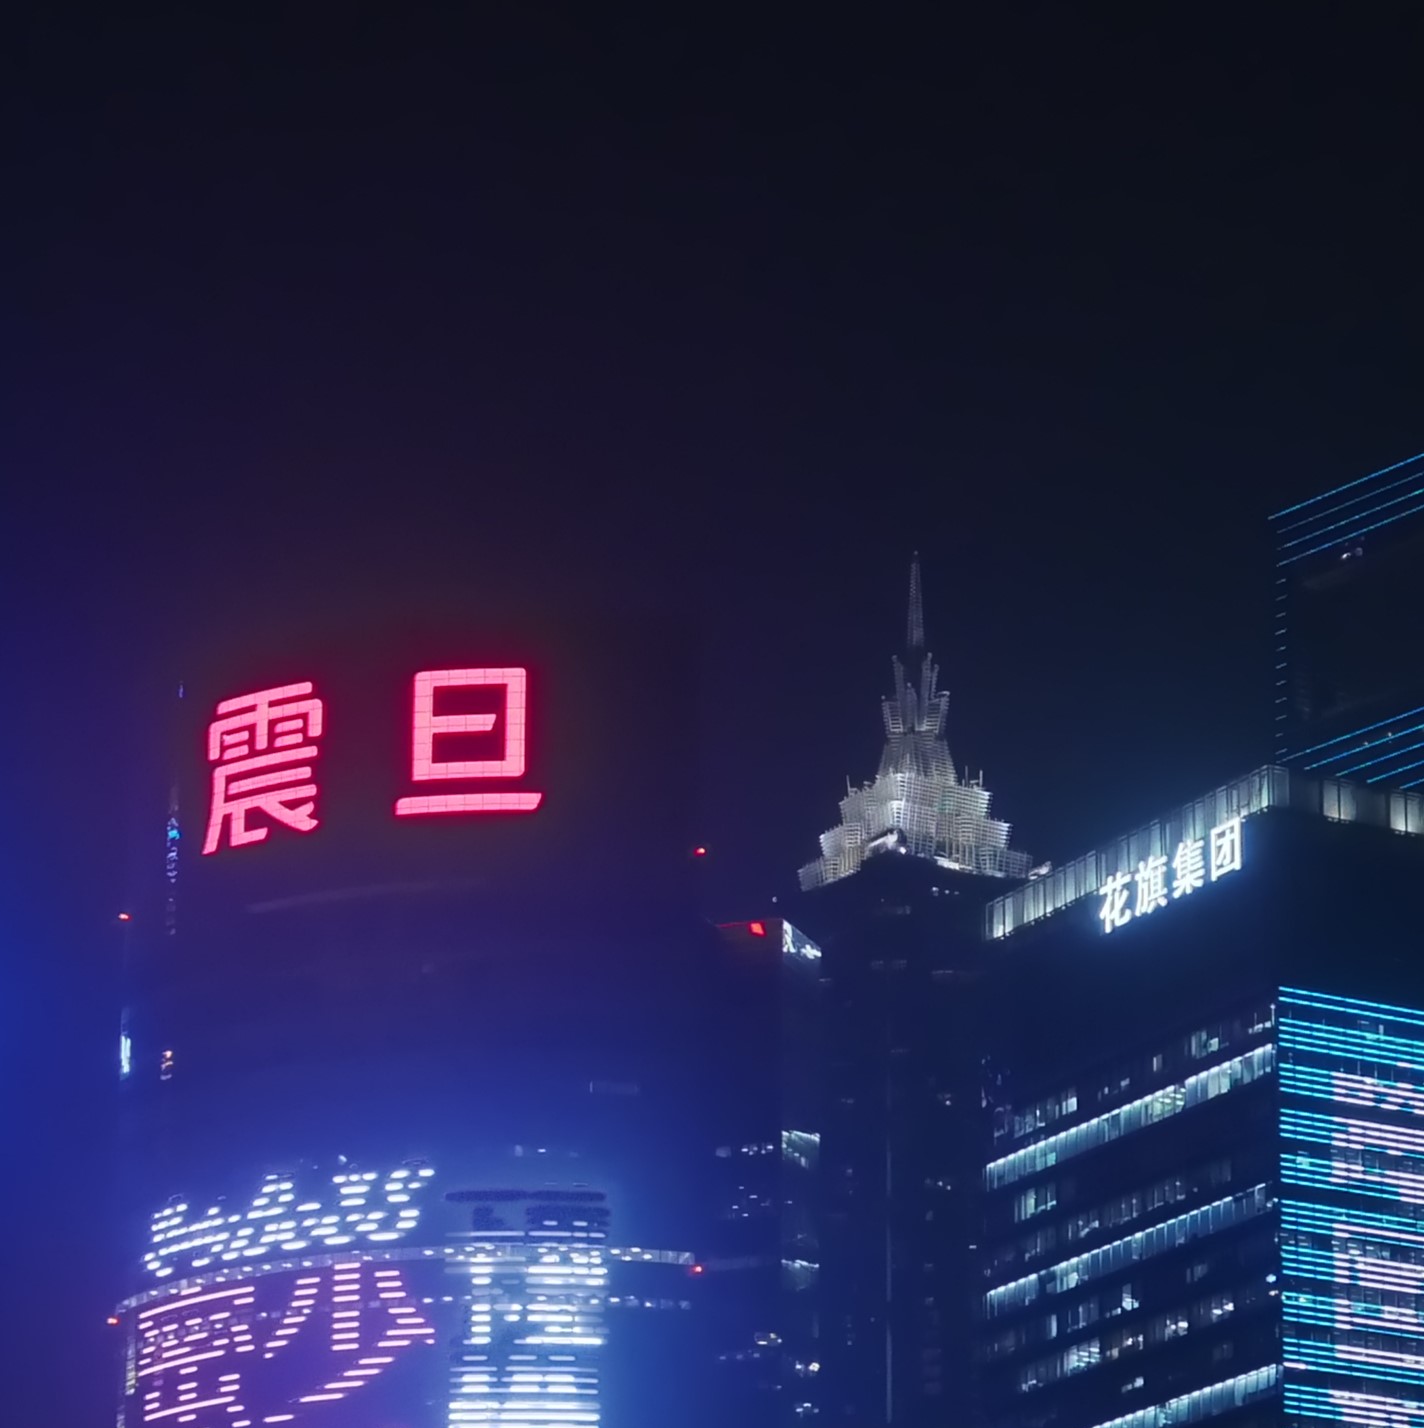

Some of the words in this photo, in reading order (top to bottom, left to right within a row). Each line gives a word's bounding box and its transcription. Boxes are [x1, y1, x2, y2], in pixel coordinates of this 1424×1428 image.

[201, 666, 544, 856] 震旦
[1098, 816, 1245, 935] 花旗集团
